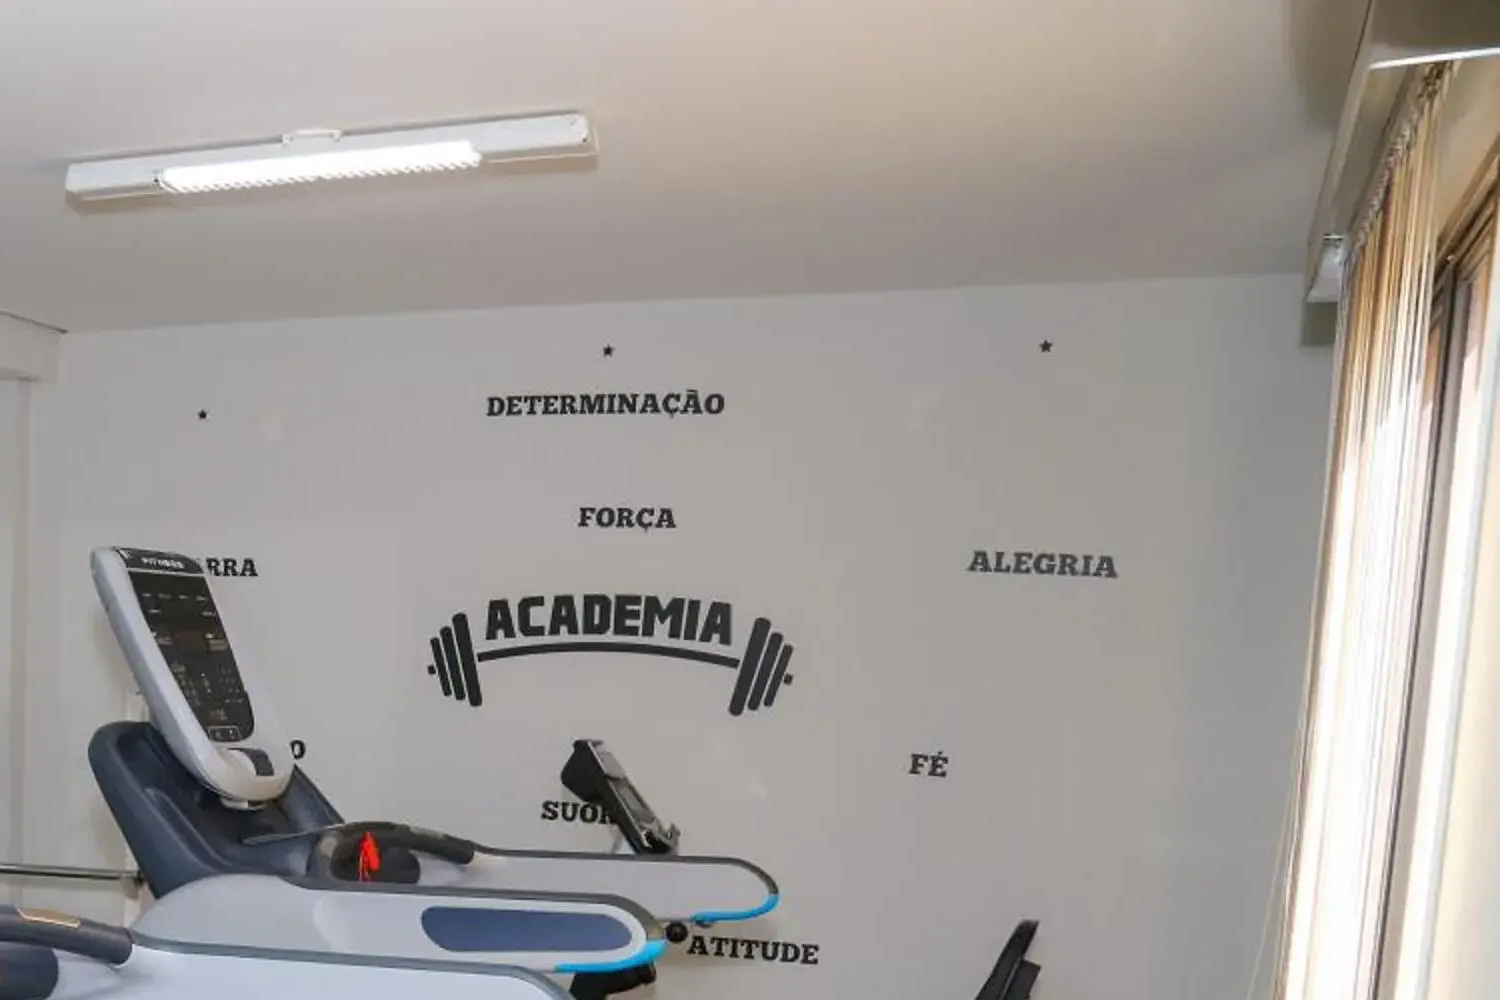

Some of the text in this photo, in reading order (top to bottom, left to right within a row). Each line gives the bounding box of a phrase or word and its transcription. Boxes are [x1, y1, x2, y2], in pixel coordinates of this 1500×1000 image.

[487, 389, 725, 418] DETERMINAÇÃO
[578, 507, 676, 532] FORÇA
[205, 557, 259, 577] RRA
[967, 550, 1119, 579] ALEGRIA
[485, 594, 732, 645] ACADEMIA
[909, 751, 949, 778] FÉ
[687, 936, 819, 965] ATITUDE
